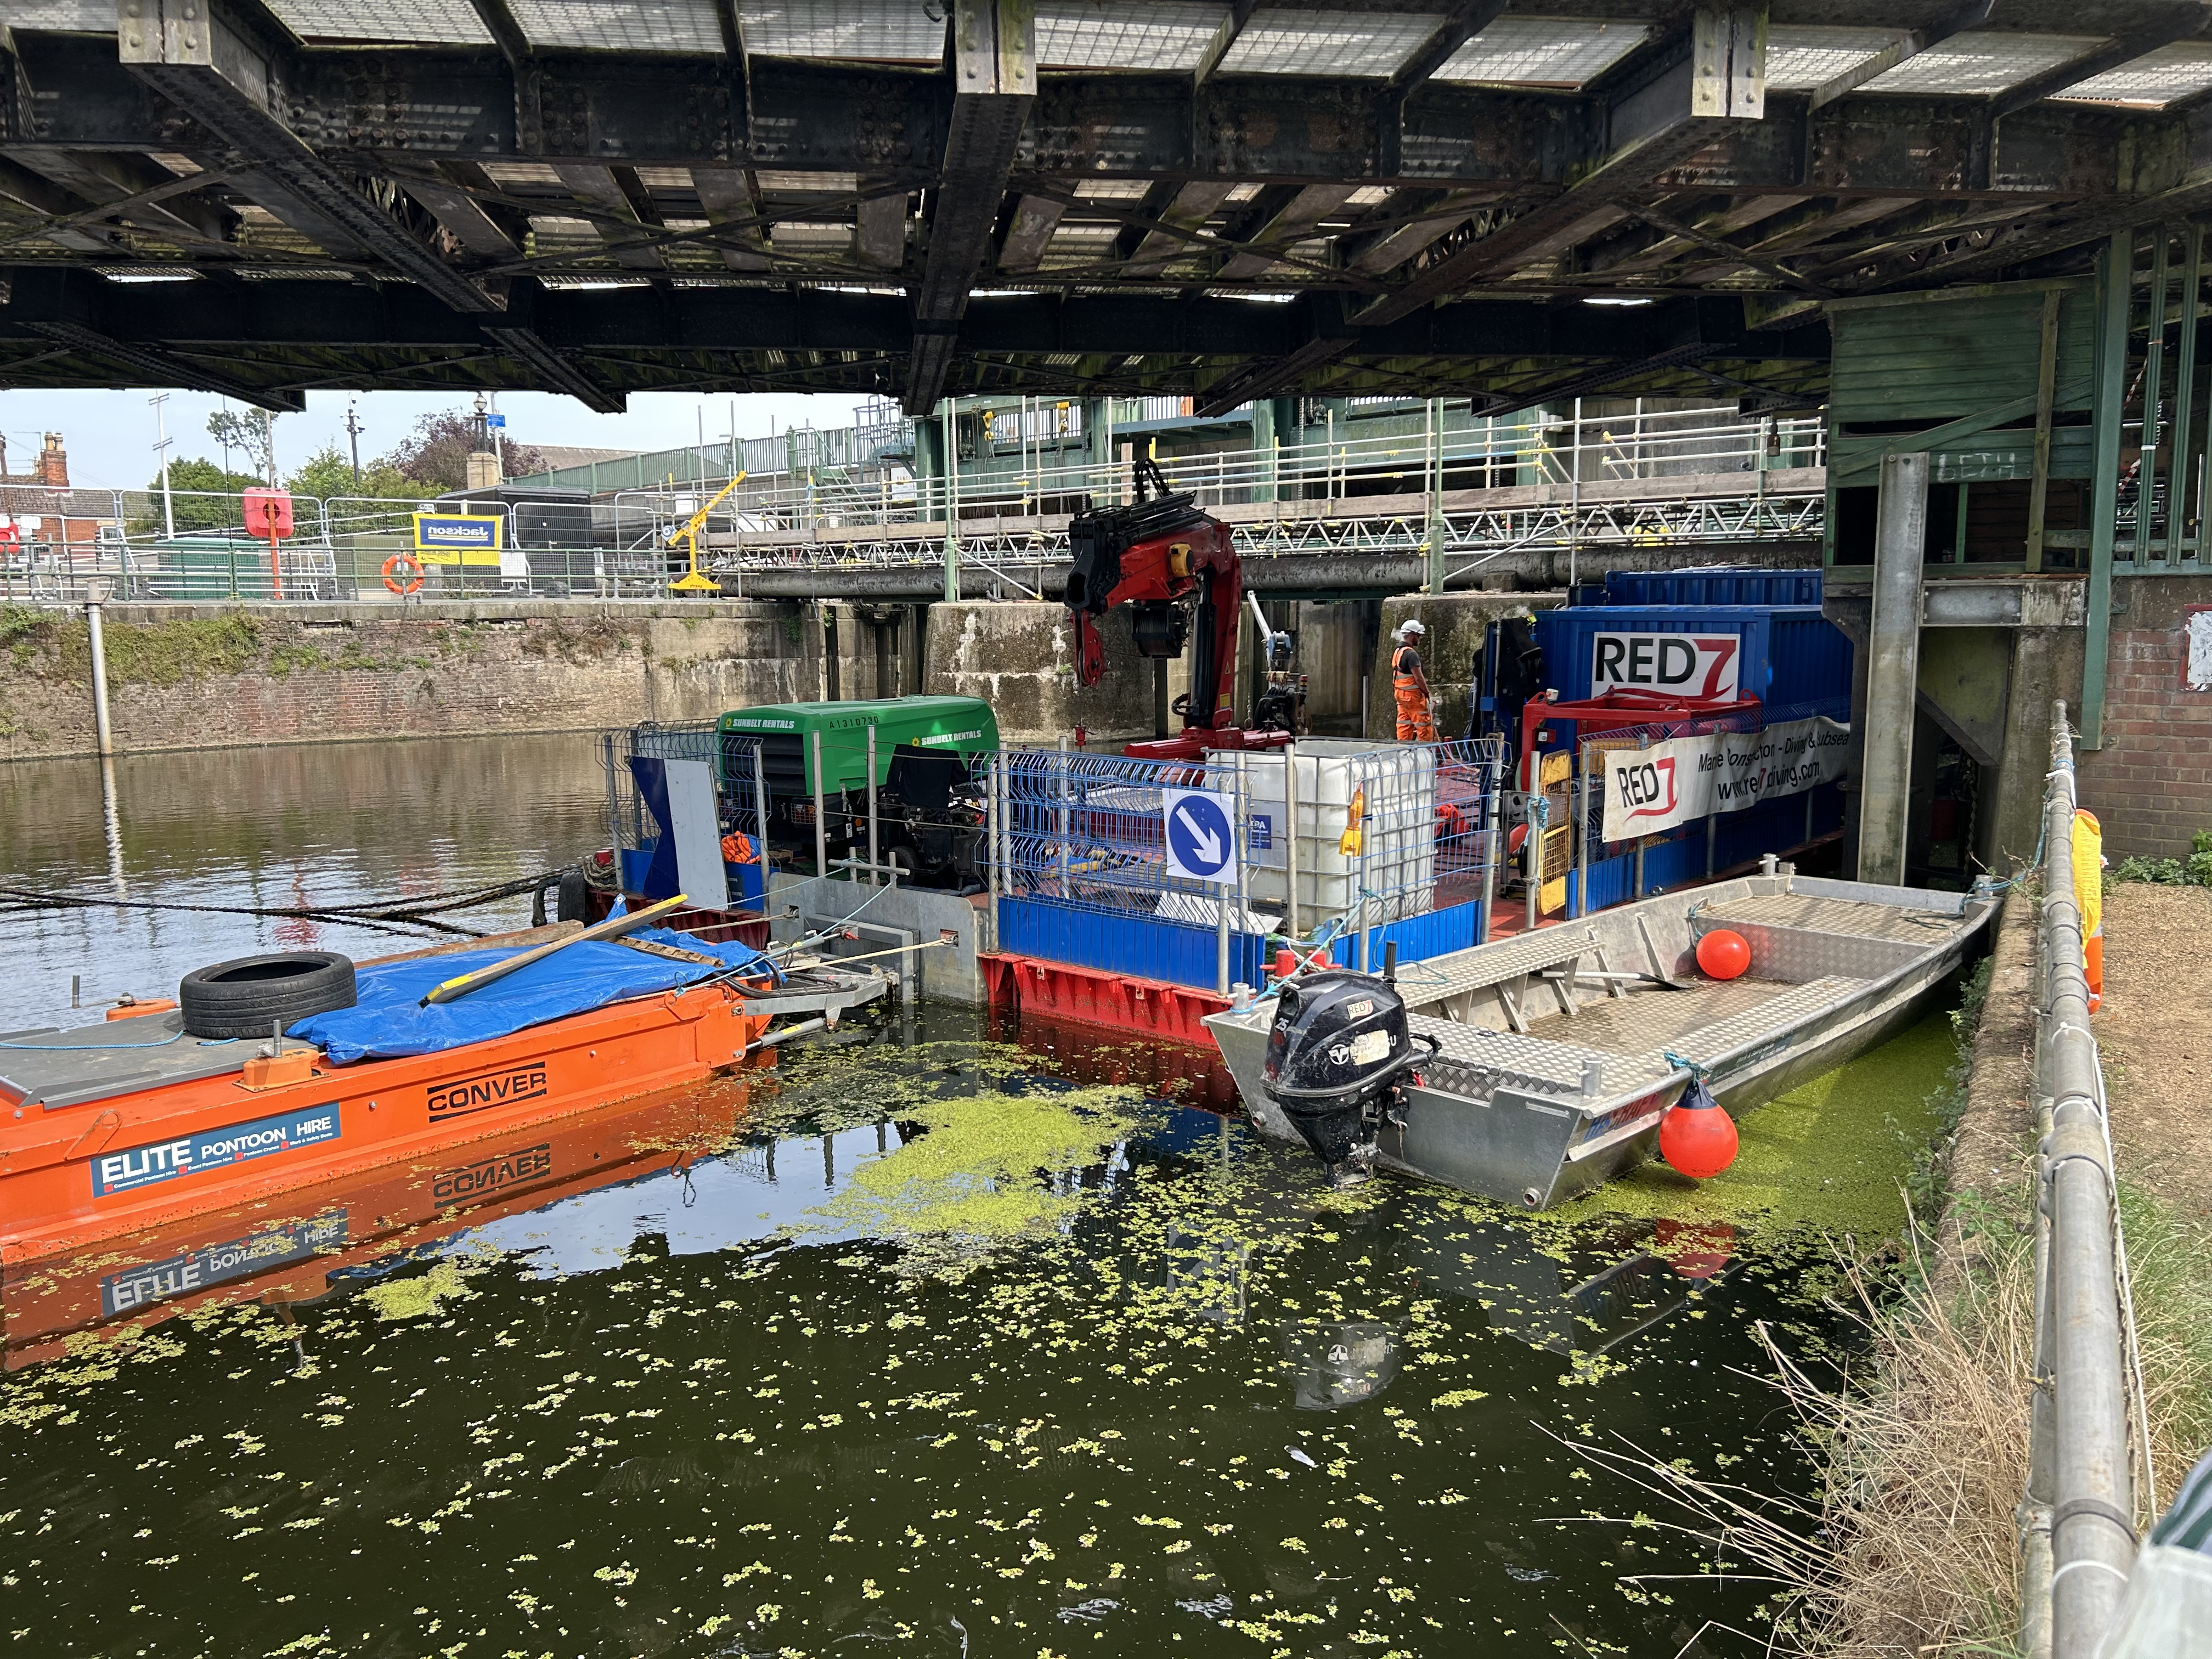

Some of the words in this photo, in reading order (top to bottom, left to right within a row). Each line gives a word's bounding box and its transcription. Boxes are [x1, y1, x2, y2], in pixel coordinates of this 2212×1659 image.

[1595, 637, 1736, 701] RED7
[733, 719, 761, 727] SUNBELT
[763, 719, 794, 729] RENTALS
[921, 733, 952, 746] SUNBELT
[953, 730, 981, 741] RENTALS
[1808, 732, 1816, 748] &
[1616, 757, 1678, 814] RED7
[1348, 1001, 1371, 1014] RED7
[1275, 1018, 1289, 1031] 25
[428, 1072, 546, 1111] CONVER
[101, 1139, 192, 1183] ELITE
[201, 1127, 286, 1159] PONTOON
[296, 1116, 332, 1136] HIRE
[244, 1149, 263, 1157] Pontoon
[202, 1159, 222, 1167] Pontoon
[114, 1178, 144, 1189] Commercial
[144, 1172, 165, 1181] Pontoon
